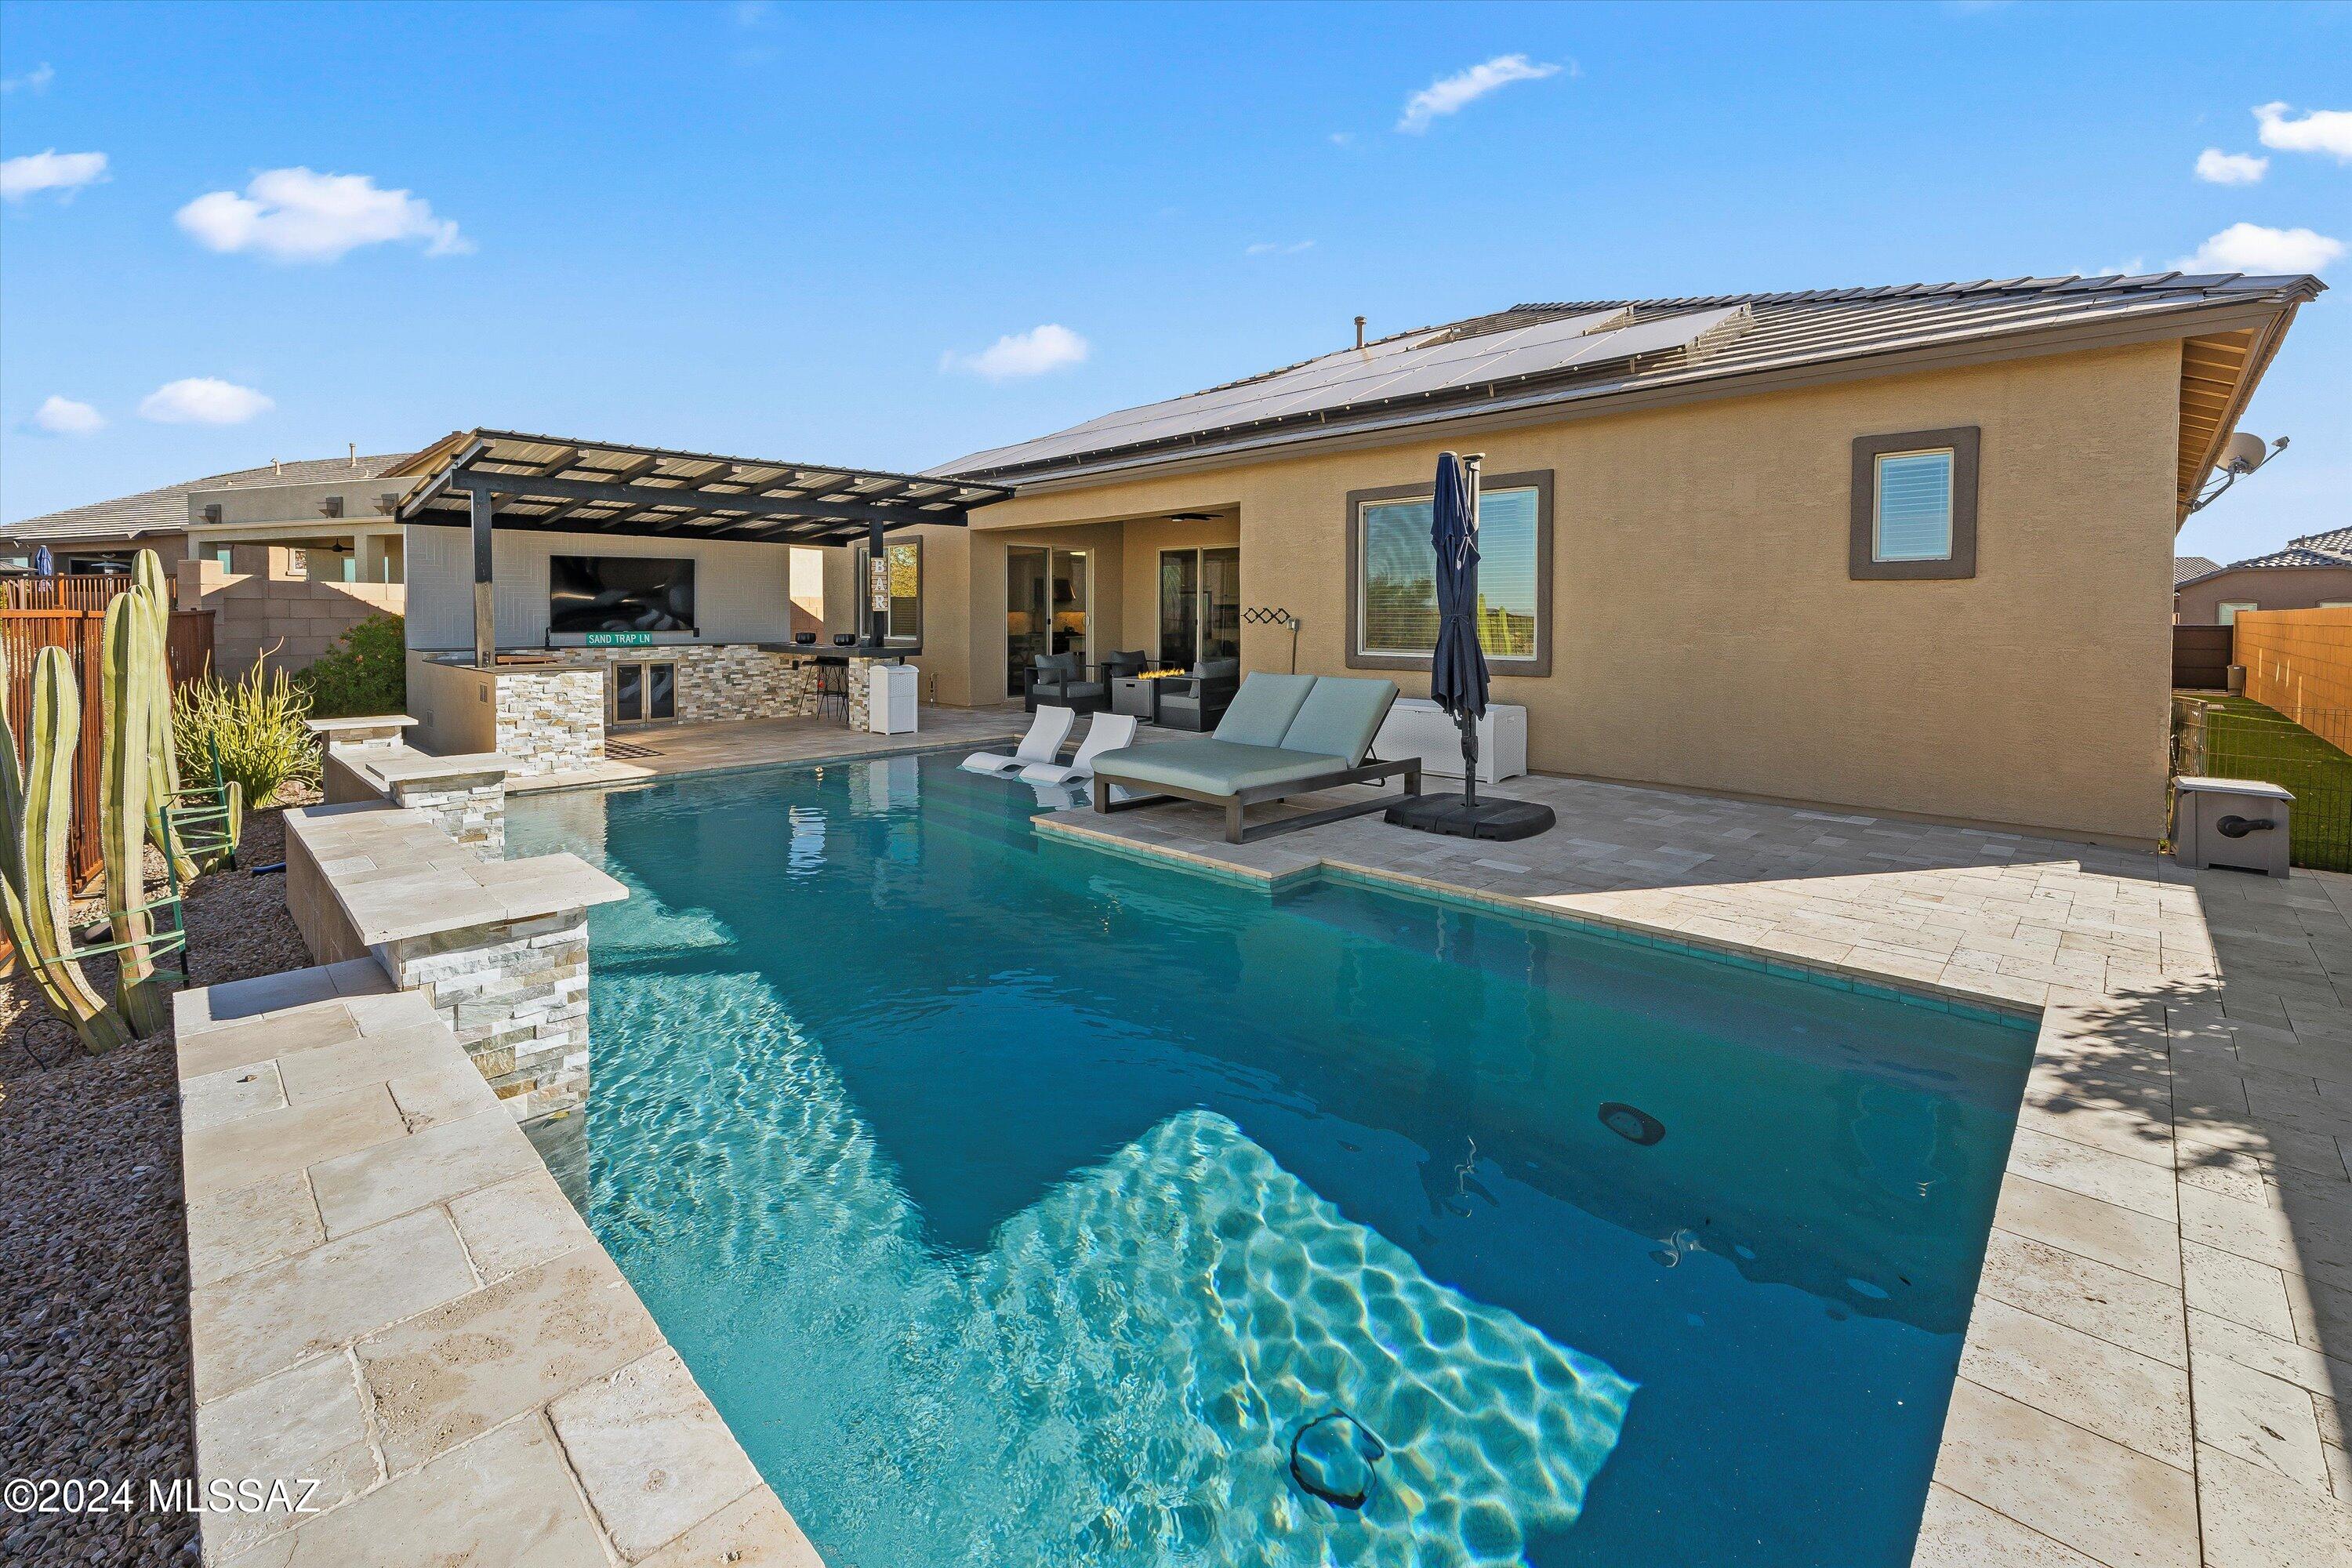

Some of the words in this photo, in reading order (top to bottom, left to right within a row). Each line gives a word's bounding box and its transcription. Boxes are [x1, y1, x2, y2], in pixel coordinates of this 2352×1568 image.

[874, 559, 886, 608] BAR
[589, 634, 612, 644] SAND
[615, 634, 637, 644] TRAP
[639, 633, 650, 643] LN
